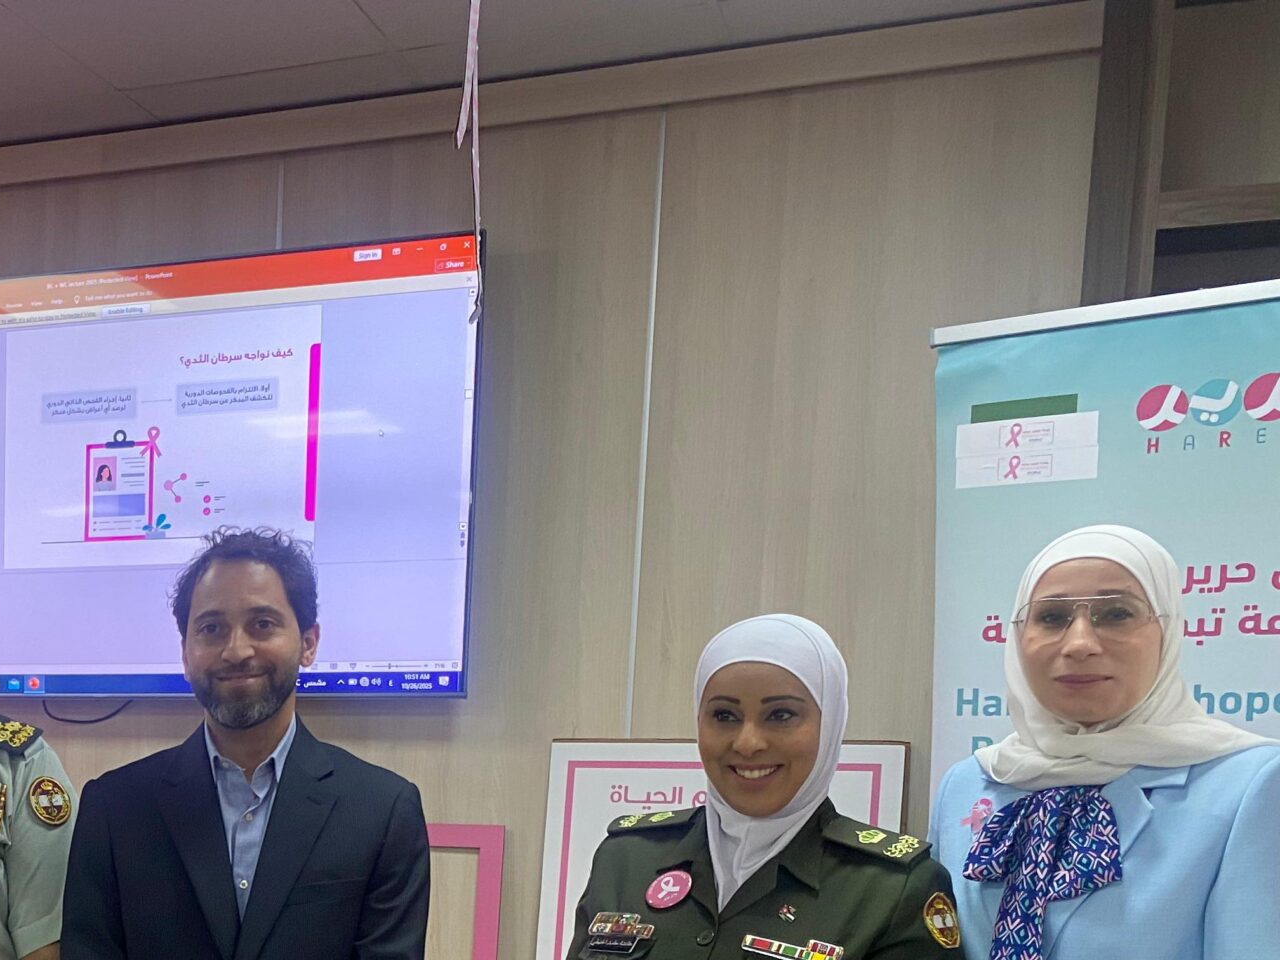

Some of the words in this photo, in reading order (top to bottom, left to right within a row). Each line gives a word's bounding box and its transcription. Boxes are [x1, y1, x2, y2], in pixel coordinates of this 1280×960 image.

[445, 259, 464, 269] Share
[211, 352, 242, 365] سرطان
[244, 349, 270, 361] نواجه
[271, 348, 293, 358] كيف
[1181, 561, 1257, 594] حرير
[419, 673, 430, 681] AM
[610, 784, 683, 810] الحياة
